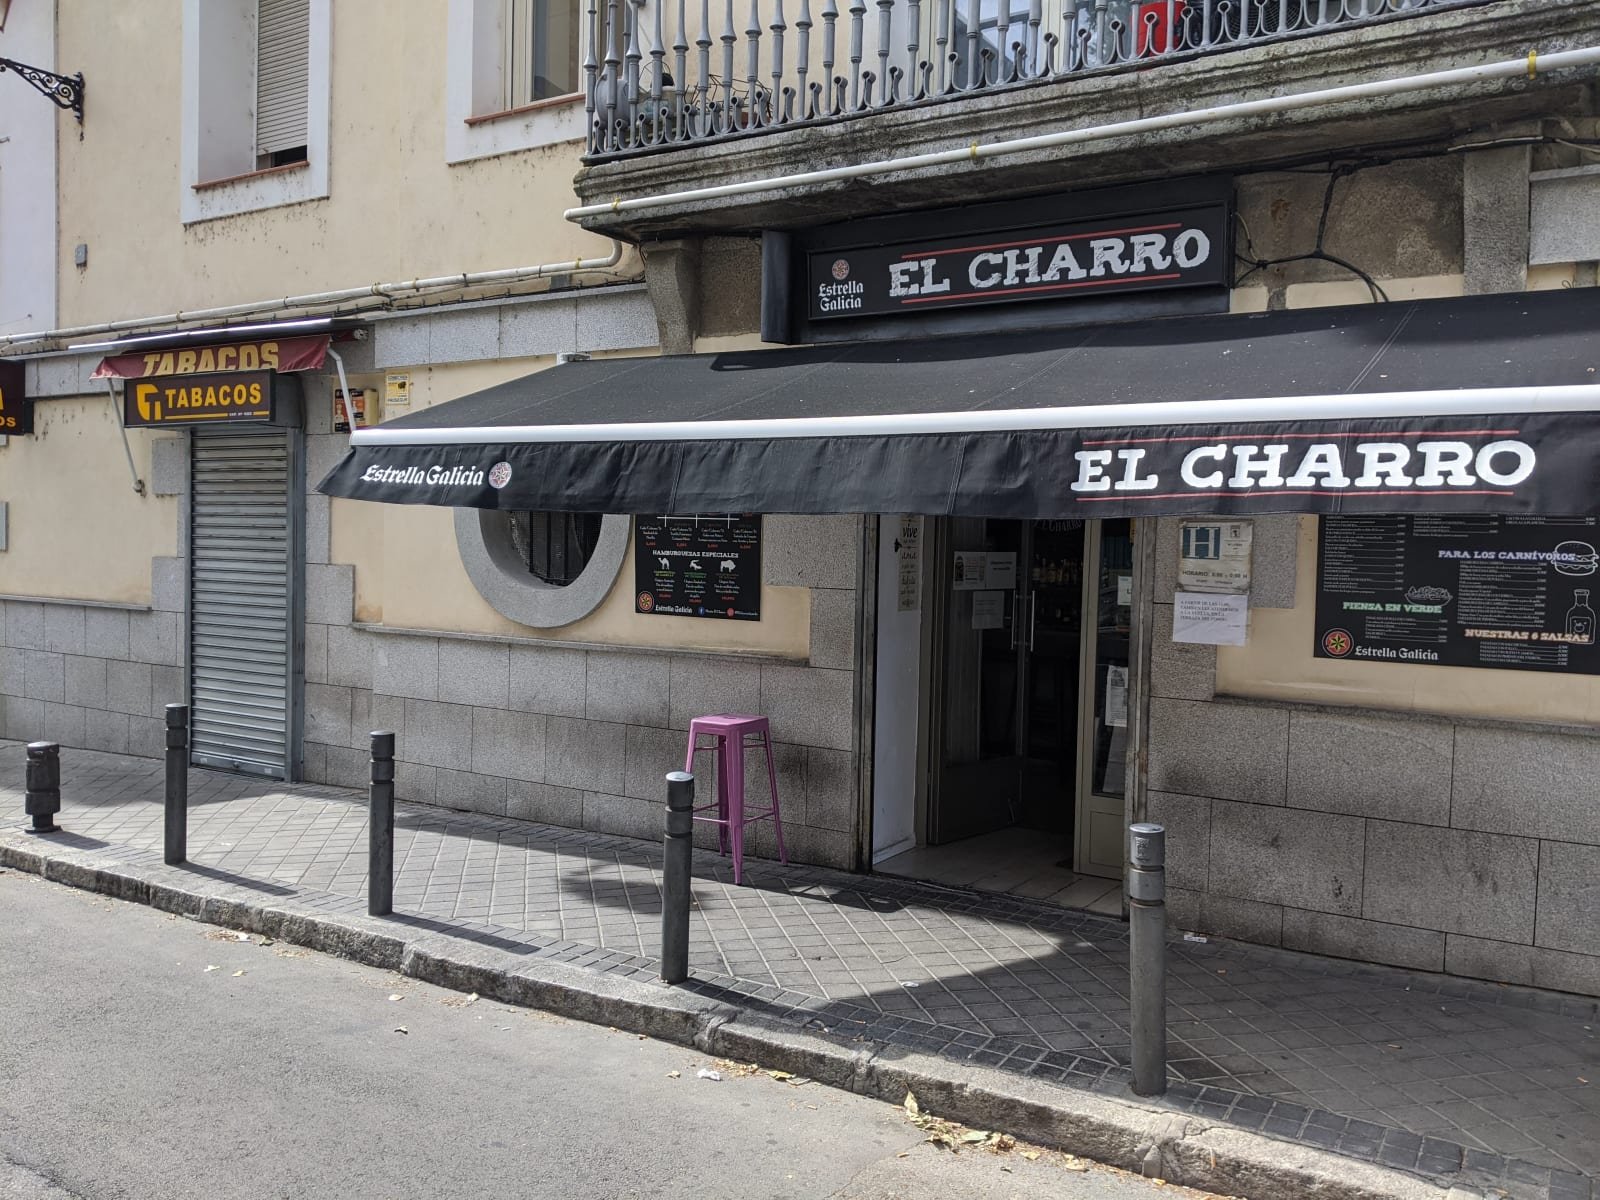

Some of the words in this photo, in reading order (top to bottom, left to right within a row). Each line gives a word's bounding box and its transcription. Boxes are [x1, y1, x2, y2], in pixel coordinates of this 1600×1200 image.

[888, 257, 950, 297] EL
[968, 228, 1210, 289] CHARRO
[819, 279, 864, 298] Estrella
[819, 295, 862, 312] Galicia
[143, 342, 279, 377] TABACOS
[165, 383, 262, 409] TABACOS
[360, 464, 425, 484] Estrella
[426, 465, 484, 486] Galicia
[1070, 447, 1158, 492] EL
[1180, 440, 1536, 489] CHARRO
[1438, 550, 1472, 559] PARA
[1474, 551, 1495, 559] LOS
[1498, 550, 1576, 561] CARNÍVOROS
[1342, 602, 1383, 611] PIENSA
[1385, 604, 1402, 612] EN
[1405, 604, 1442, 613] VERDE
[1464, 629, 1529, 640] NUESTRAS
[1540, 632, 1590, 642] SALSAS
[1354, 645, 1397, 658] Estrella
[1398, 648, 1439, 660] Galicia
